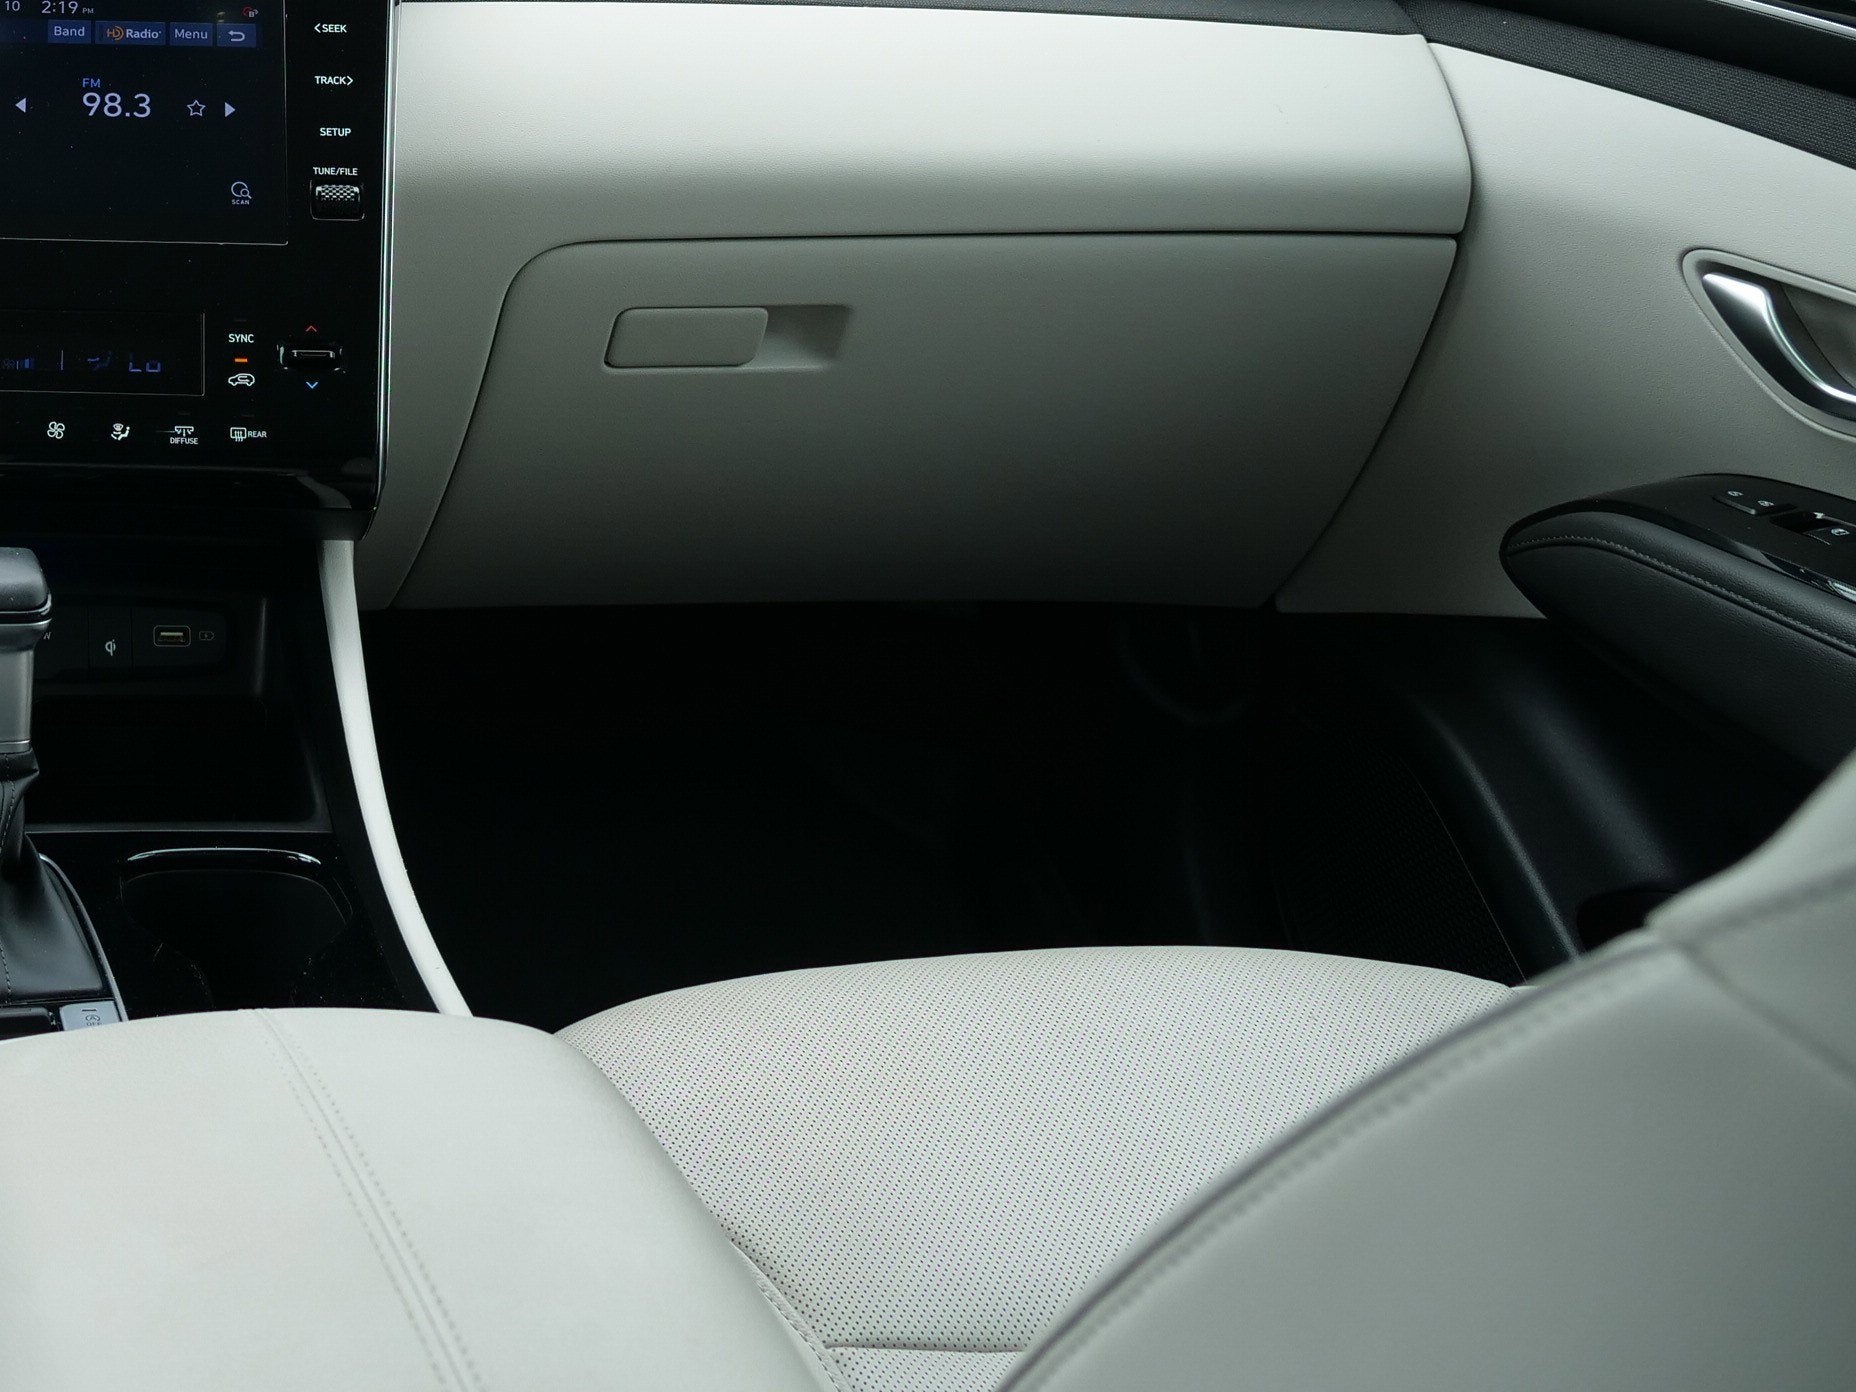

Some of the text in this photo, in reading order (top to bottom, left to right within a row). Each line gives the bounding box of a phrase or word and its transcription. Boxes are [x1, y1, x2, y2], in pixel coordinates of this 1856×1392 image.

[4, 0, 21, 12] 10
[41, 0, 79, 14] 2:19
[53, 25, 85, 37] Band
[126, 28, 159, 39] Radio
[174, 28, 208, 39] Menu
[82, 77, 101, 88] FM
[82, 91, 151, 118] 98.3
[319, 127, 352, 137] SETUP
[312, 166, 358, 176] TUNE/FILE
[228, 333, 255, 344] SYNC
[247, 430, 267, 439] REAR
[169, 437, 199, 446] DIFFUSE
